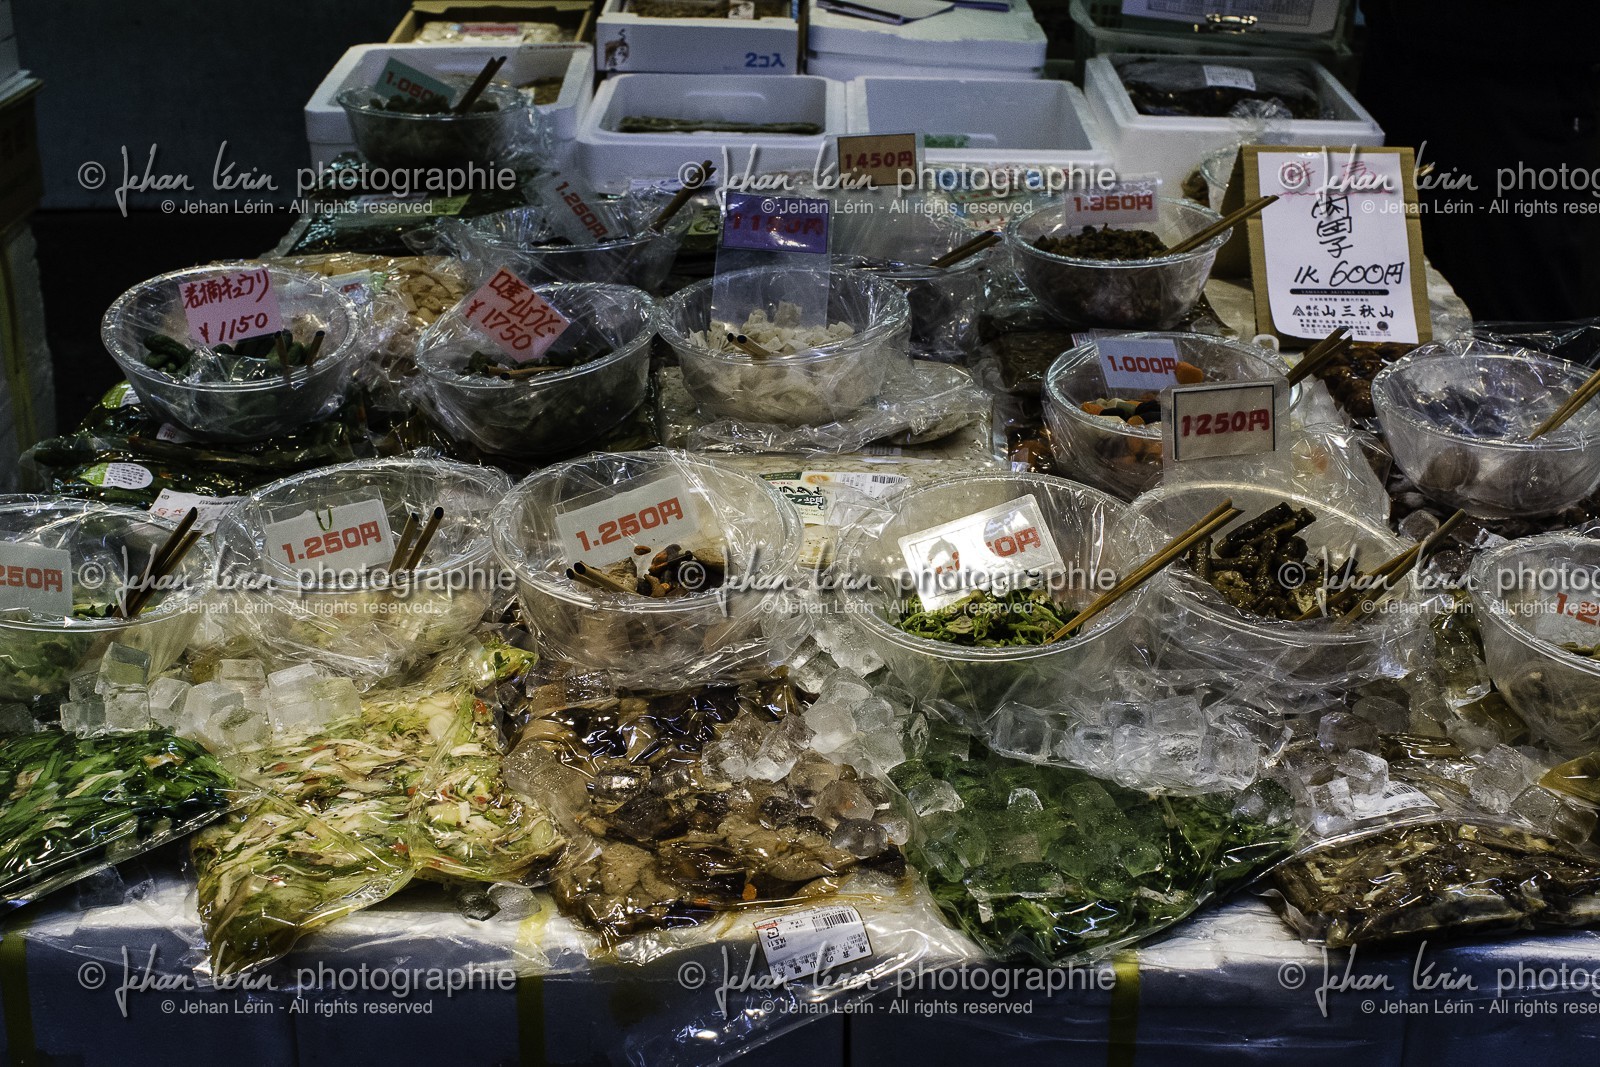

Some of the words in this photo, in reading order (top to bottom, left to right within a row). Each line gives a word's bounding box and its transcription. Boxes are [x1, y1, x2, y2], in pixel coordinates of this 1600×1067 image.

[745, 52, 785, 68] 2コ入
[844, 150, 913, 169] 1450円
[1073, 194, 1154, 213] 1.350円
[1329, 260, 1405, 287] 600円
[1321, 304, 1394, 318] 山三秋山
[1107, 355, 1178, 376] 1.000円
[1181, 408, 1271, 438] 1250円
[575, 497, 683, 552] 1.250円
[282, 520, 382, 564] 1.250円
